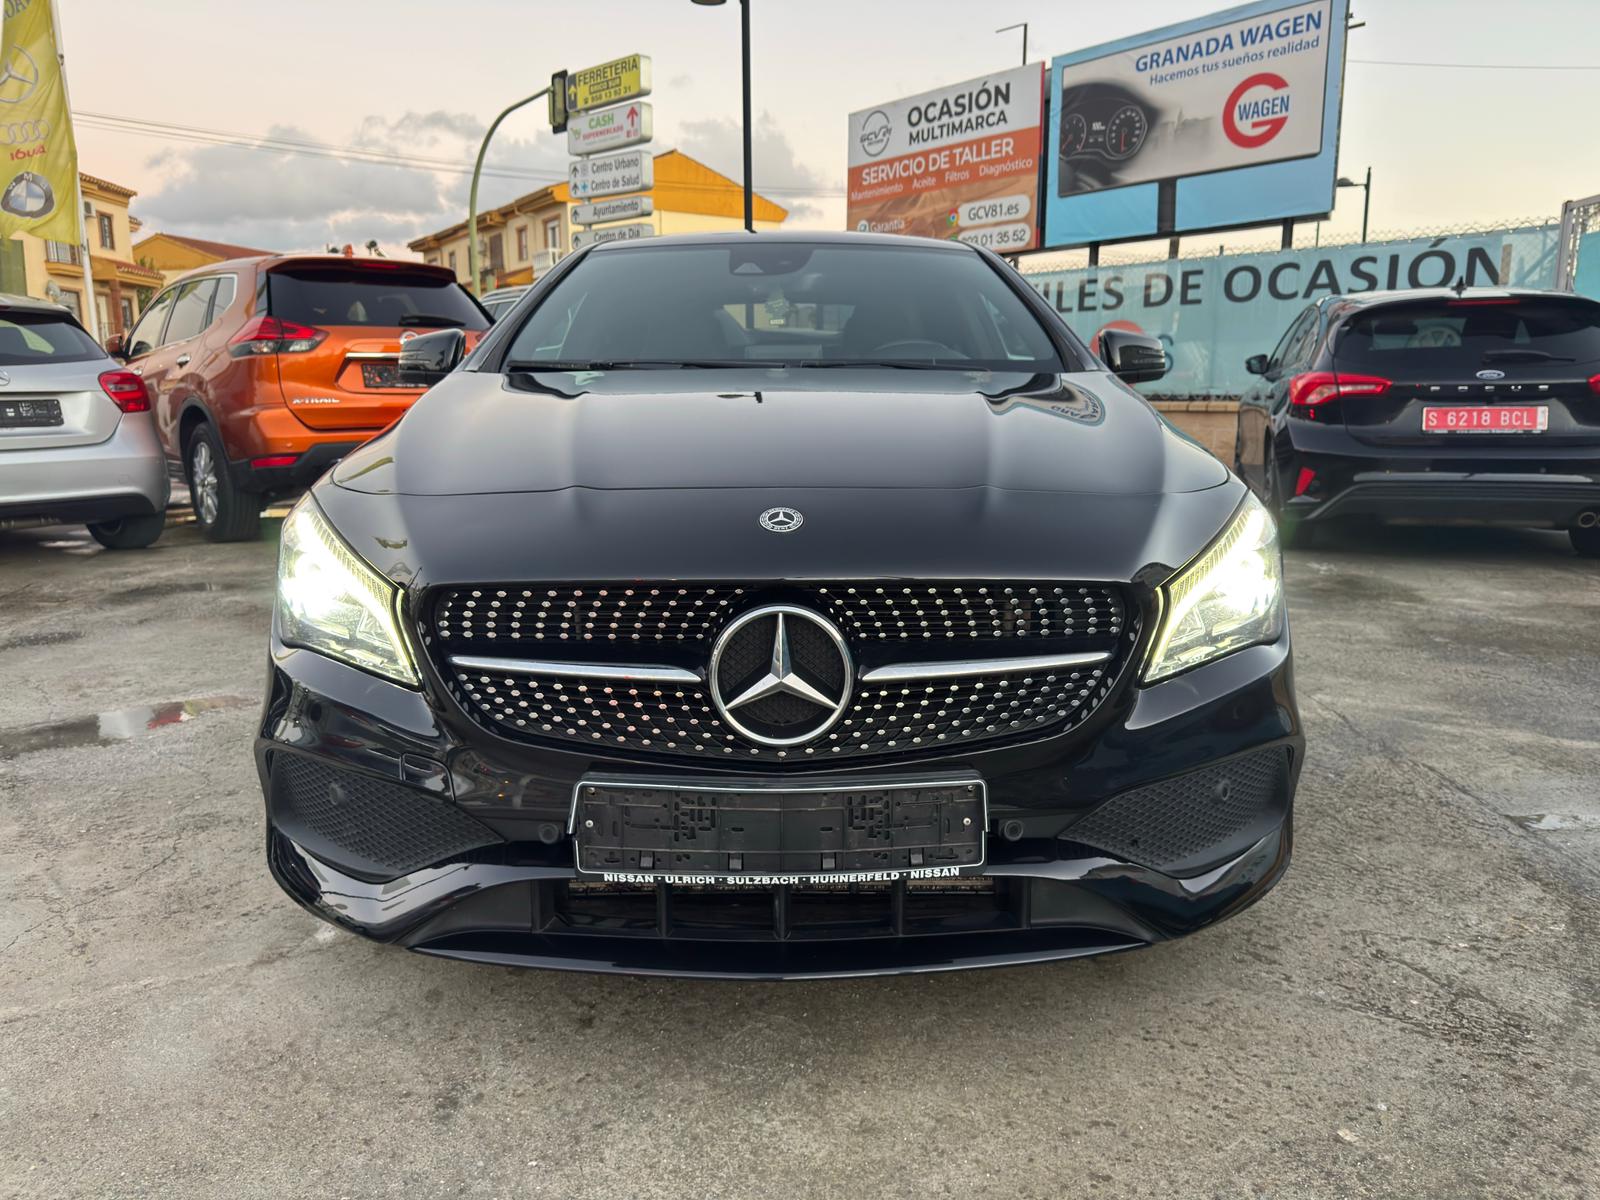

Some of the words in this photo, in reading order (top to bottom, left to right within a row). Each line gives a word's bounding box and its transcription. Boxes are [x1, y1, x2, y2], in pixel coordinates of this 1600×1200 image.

[1135, 34, 1235, 73] GRANADA
[1240, 10, 1322, 47] WAGEN
[1150, 66, 1200, 86] Hacemos
[1202, 61, 1220, 74] tus
[1221, 51, 1264, 70] sueños
[1267, 36, 1320, 59] realidad
[577, 57, 638, 87] FERRETERIA
[907, 81, 1011, 127] OCASIÓN
[1238, 95, 1291, 122] WAGEN
[588, 112, 615, 130] CASH
[908, 110, 1008, 146] MULTIMARCA
[591, 162, 614, 175] Centro
[614, 158, 640, 171] Urbano
[862, 156, 926, 186] SERVICIO
[928, 151, 950, 172] DE
[952, 137, 1014, 167] TALLER
[979, 159, 1033, 177] Diagnóstico
[591, 180, 611, 192] Centro
[612, 178, 620, 188] de
[621, 174, 640, 187] Salud
[593, 202, 639, 218] Ayuntamiento
[967, 202, 1020, 221] GCV81.es
[996, 231, 1010, 244] 35
[1012, 229, 1026, 242] 52
[1143, 270, 1204, 308] DE
[1224, 238, 1513, 303] OCASIÓN
[1428, 412, 1438, 426] S
[1447, 411, 1491, 426] 6218
[1501, 411, 1532, 426] BCL
[603, 873, 654, 884] NISSAN
[665, 875, 715, 885] ULRICH
[727, 876, 799, 886] SULZBACH
[910, 867, 960, 880] NISSAN
